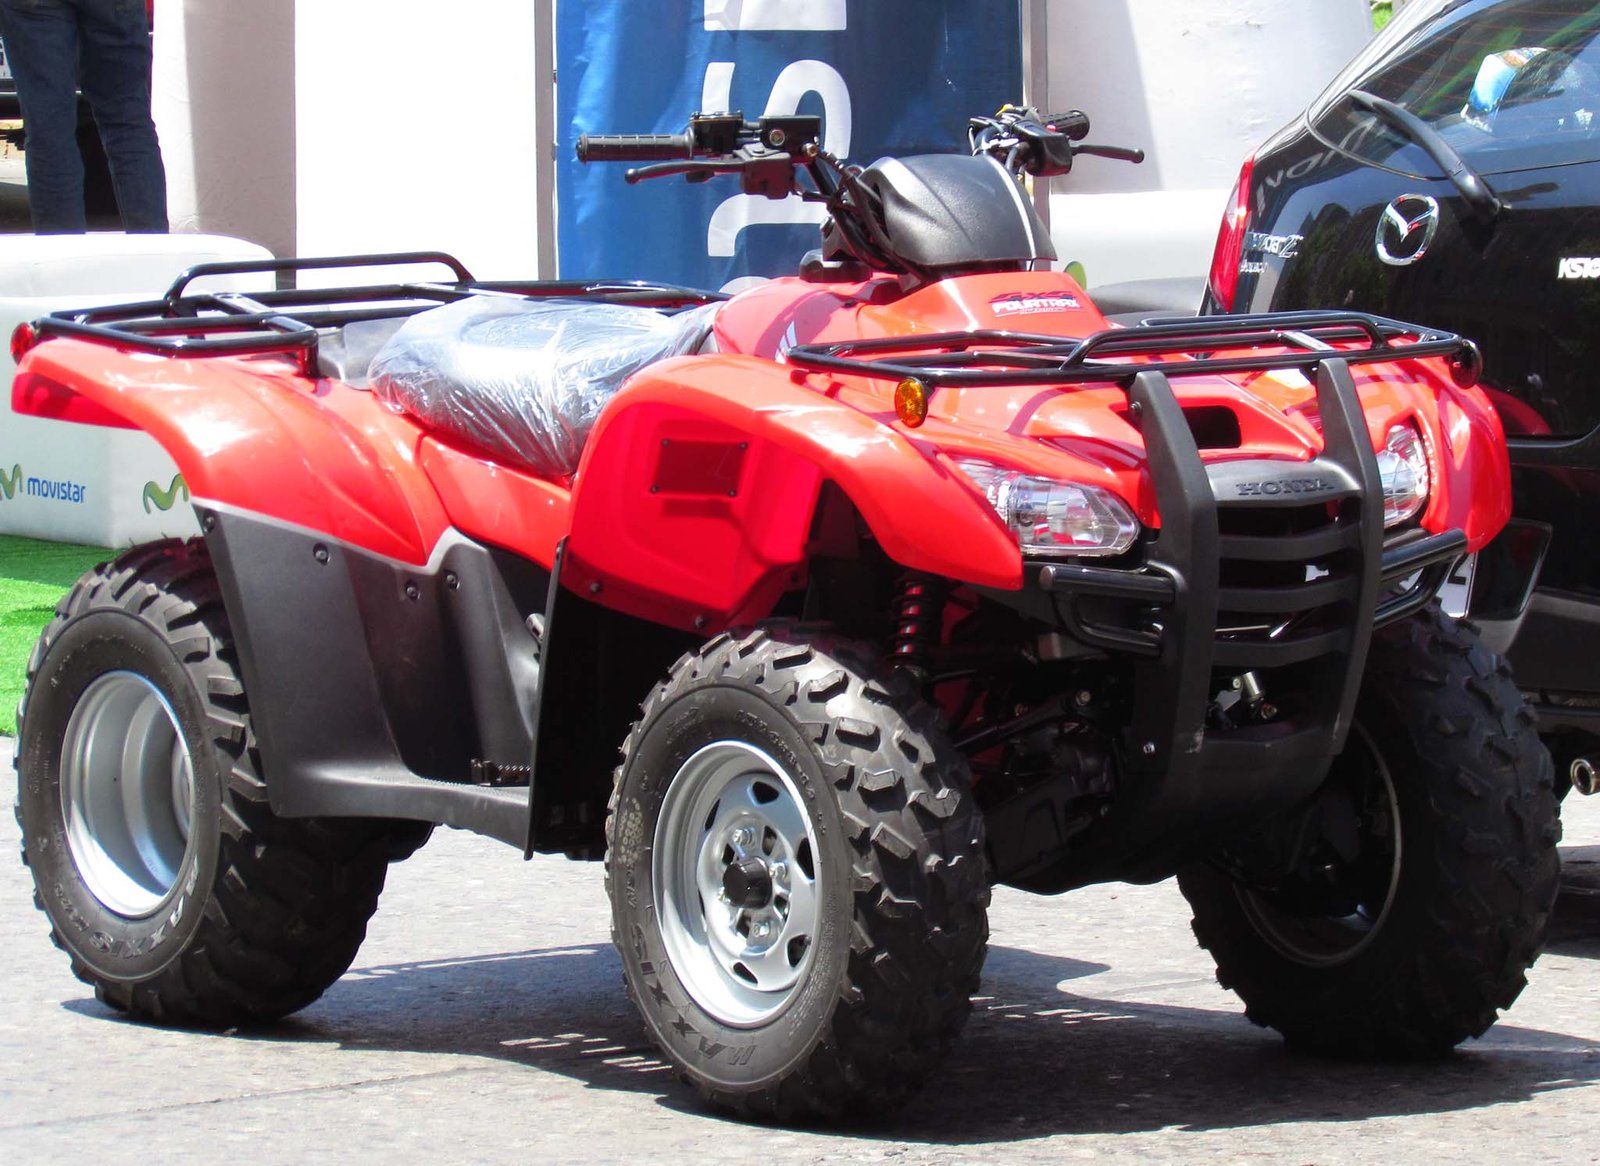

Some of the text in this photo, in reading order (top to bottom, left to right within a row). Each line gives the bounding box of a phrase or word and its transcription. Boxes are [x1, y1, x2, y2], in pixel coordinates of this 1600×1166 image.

[27, 477, 86, 504] movistar
[1236, 479, 1335, 496] HONDA
[89, 853, 200, 960] MAXXIS
[630, 923, 757, 1066] MAXXIS
